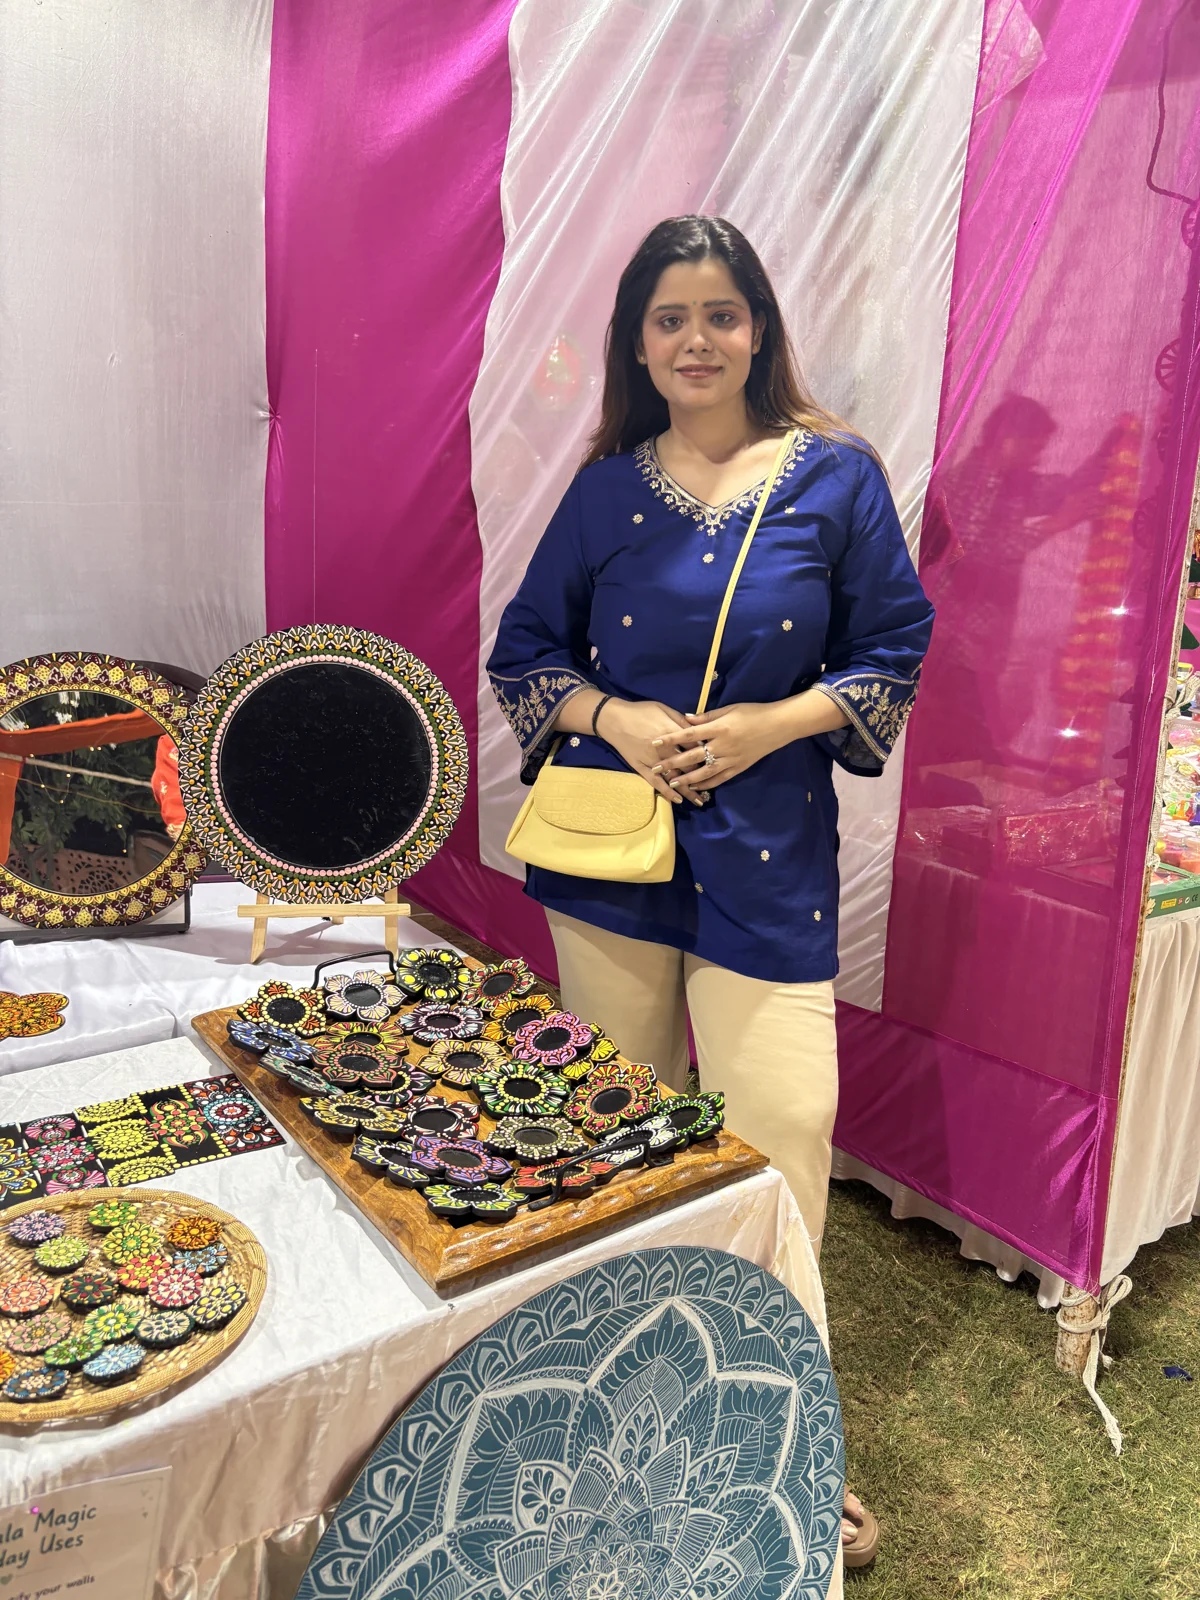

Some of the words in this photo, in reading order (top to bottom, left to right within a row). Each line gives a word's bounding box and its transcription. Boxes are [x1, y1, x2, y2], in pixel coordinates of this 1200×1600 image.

[0, 1523, 24, 1544] la
[34, 1504, 97, 1532] Magic
[40, 1533, 84, 1554] Uses
[35, 1584, 62, 1600] your
[66, 1574, 96, 1589] walls
